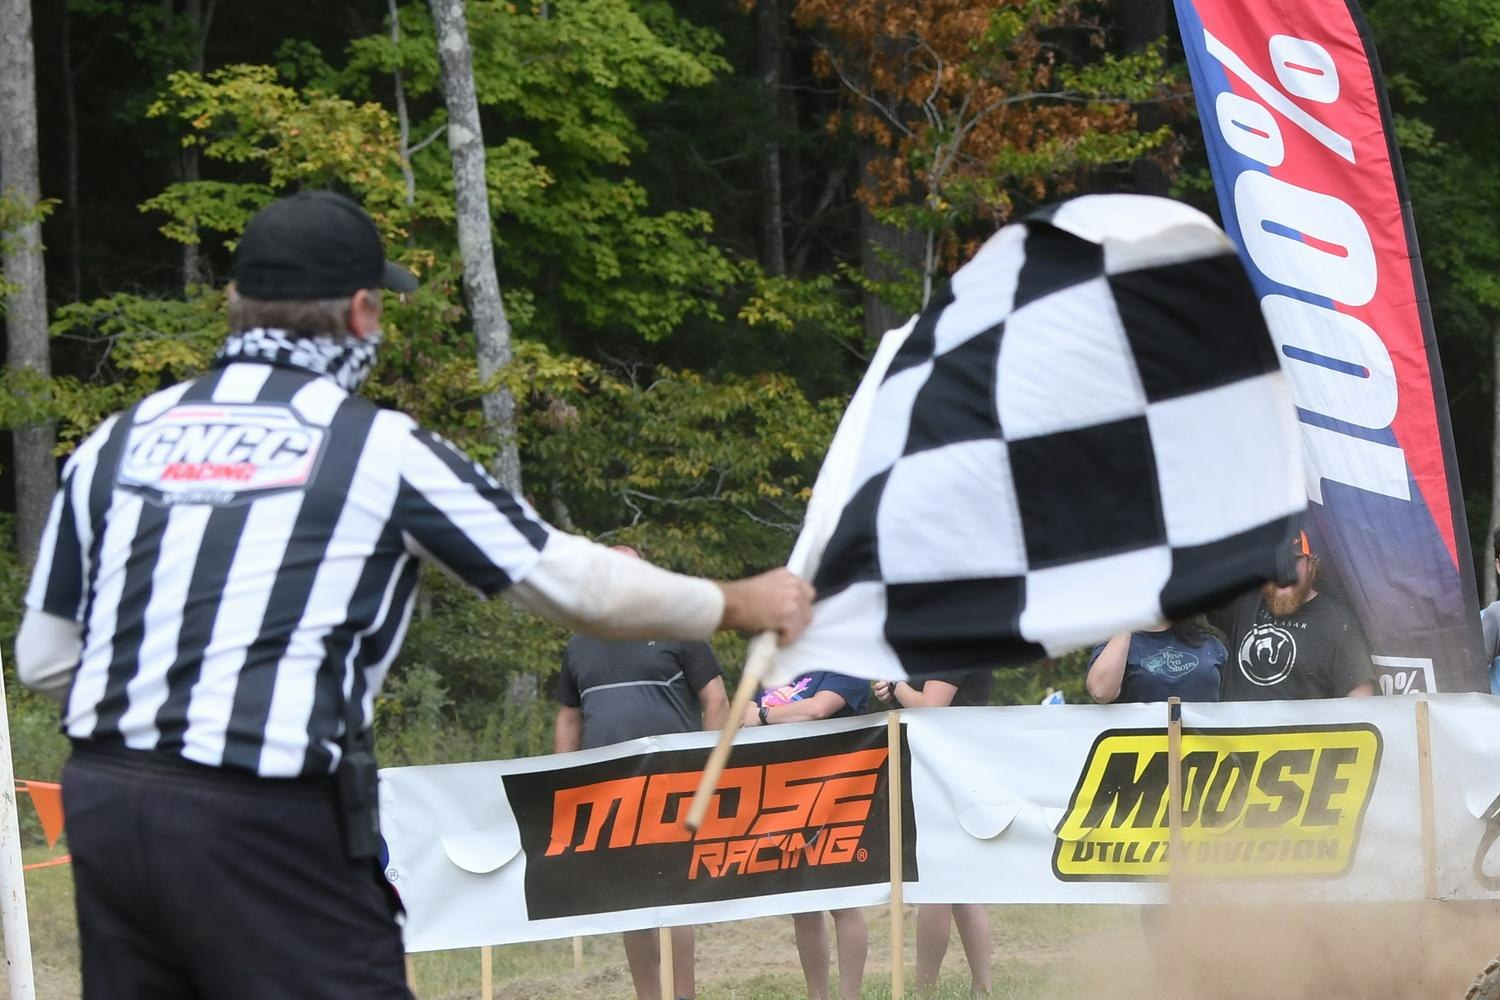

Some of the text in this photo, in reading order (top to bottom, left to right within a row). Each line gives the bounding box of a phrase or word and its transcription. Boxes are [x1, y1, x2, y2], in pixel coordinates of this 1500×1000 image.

[1203, 28, 1412, 506] 100%
[129, 423, 311, 467] GNCC
[160, 462, 257, 480] RACING
[545, 747, 890, 857] MOOSE
[1079, 747, 1360, 829] MOOSE
[1197, 837, 1341, 863] DIVISION
